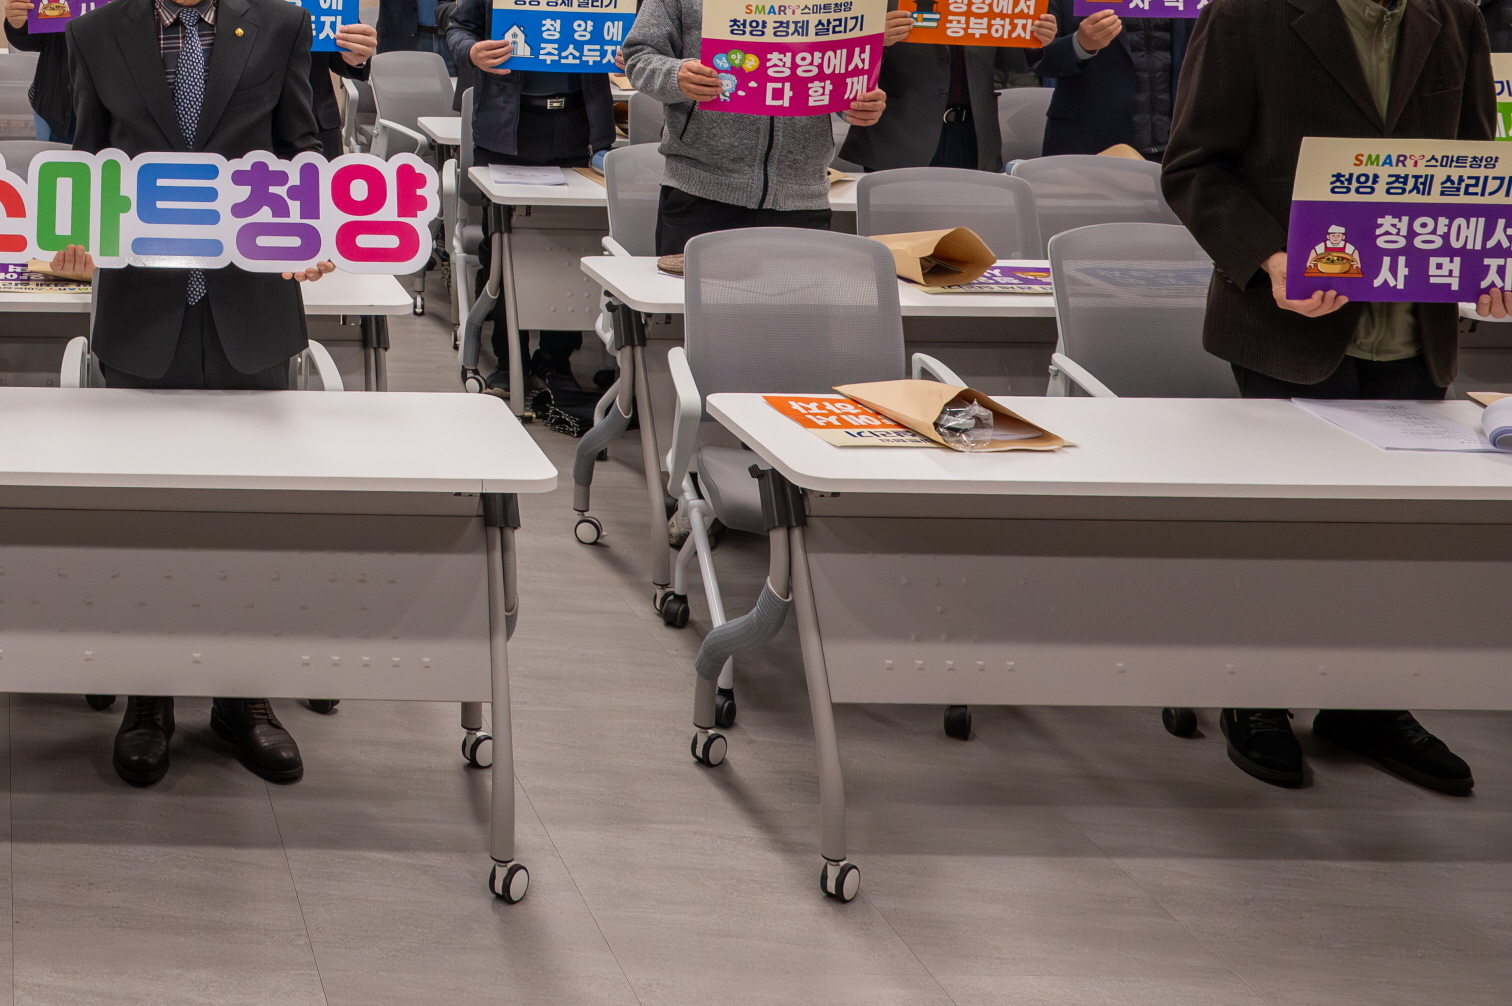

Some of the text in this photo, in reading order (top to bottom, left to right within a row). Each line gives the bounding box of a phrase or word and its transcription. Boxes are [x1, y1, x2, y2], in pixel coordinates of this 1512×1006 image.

[729, 15, 864, 38] 청양 경제 살리기
[766, 45, 870, 77] 청양에서
[1330, 172, 1379, 195] 청양
[1385, 173, 1434, 196] 경제
